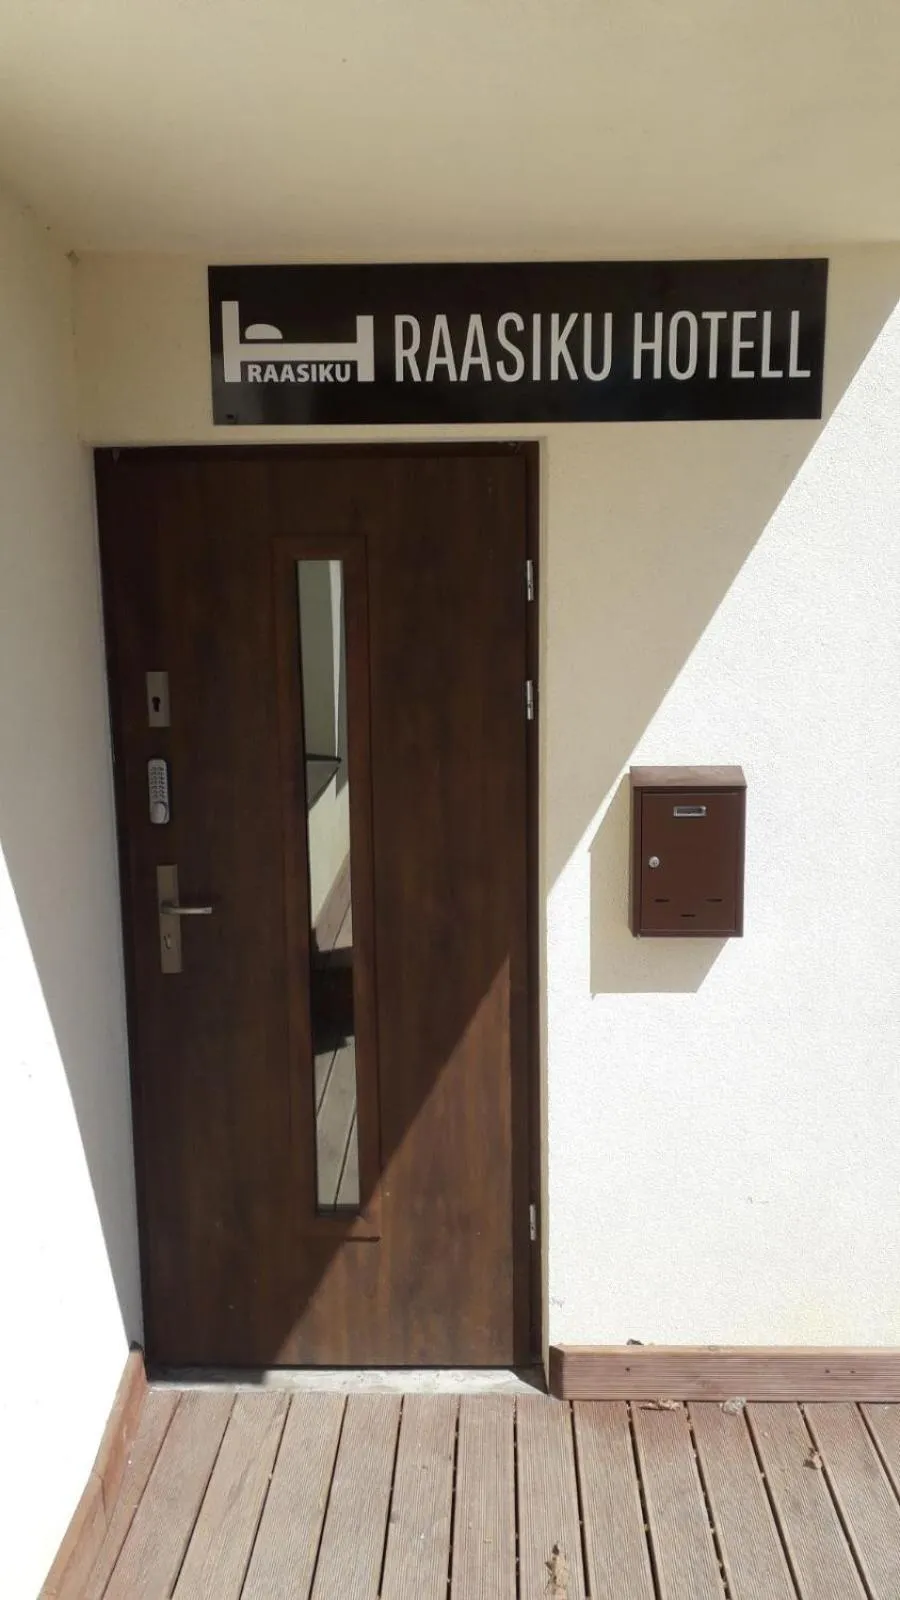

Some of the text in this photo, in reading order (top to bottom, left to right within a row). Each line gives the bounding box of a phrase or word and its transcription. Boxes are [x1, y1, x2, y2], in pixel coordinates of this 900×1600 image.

[394, 310, 811, 383] RAASIKU HOTELL
[247, 363, 352, 383] RAASIKU
